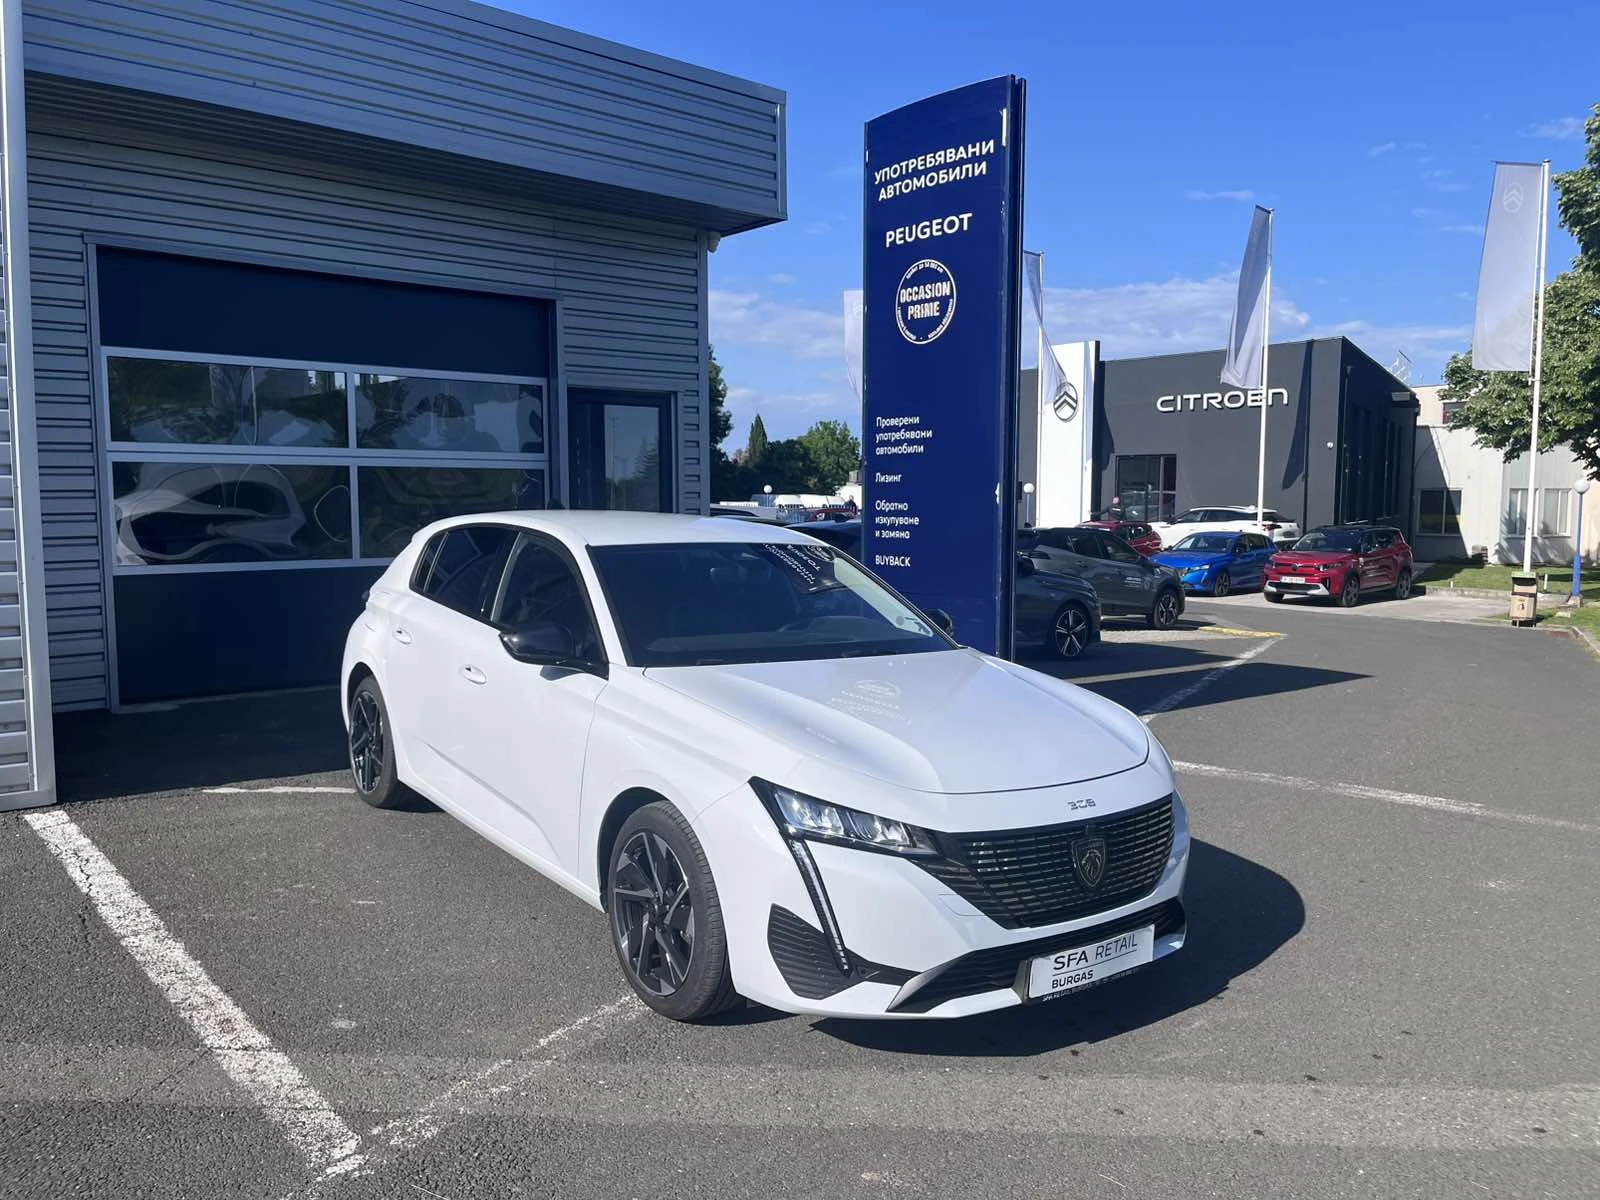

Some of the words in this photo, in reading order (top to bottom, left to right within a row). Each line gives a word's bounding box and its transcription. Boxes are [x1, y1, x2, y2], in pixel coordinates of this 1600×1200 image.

[874, 139, 995, 184] УПОТРЕБЯВАНИ
[878, 161, 987, 201] АВТОМОБИЛИ
[885, 213, 973, 248] PEUGEOT
[900, 280, 951, 304] OCCASION
[907, 301, 940, 320] PRIME
[876, 416, 920, 429] Проверени
[875, 429, 933, 443] употребявани
[875, 444, 924, 456] автомобили
[875, 472, 902, 483] Лизинг
[875, 500, 909, 512] Обратно
[875, 515, 920, 527] изкупуване
[875, 530, 880, 538] и
[881, 529, 910, 539] замяна
[875, 554, 911, 567] BUYBACK
[1053, 950, 1089, 971] SFA
[1094, 933, 1138, 961] RETAIL
[1052, 969, 1094, 989] BURGAS
